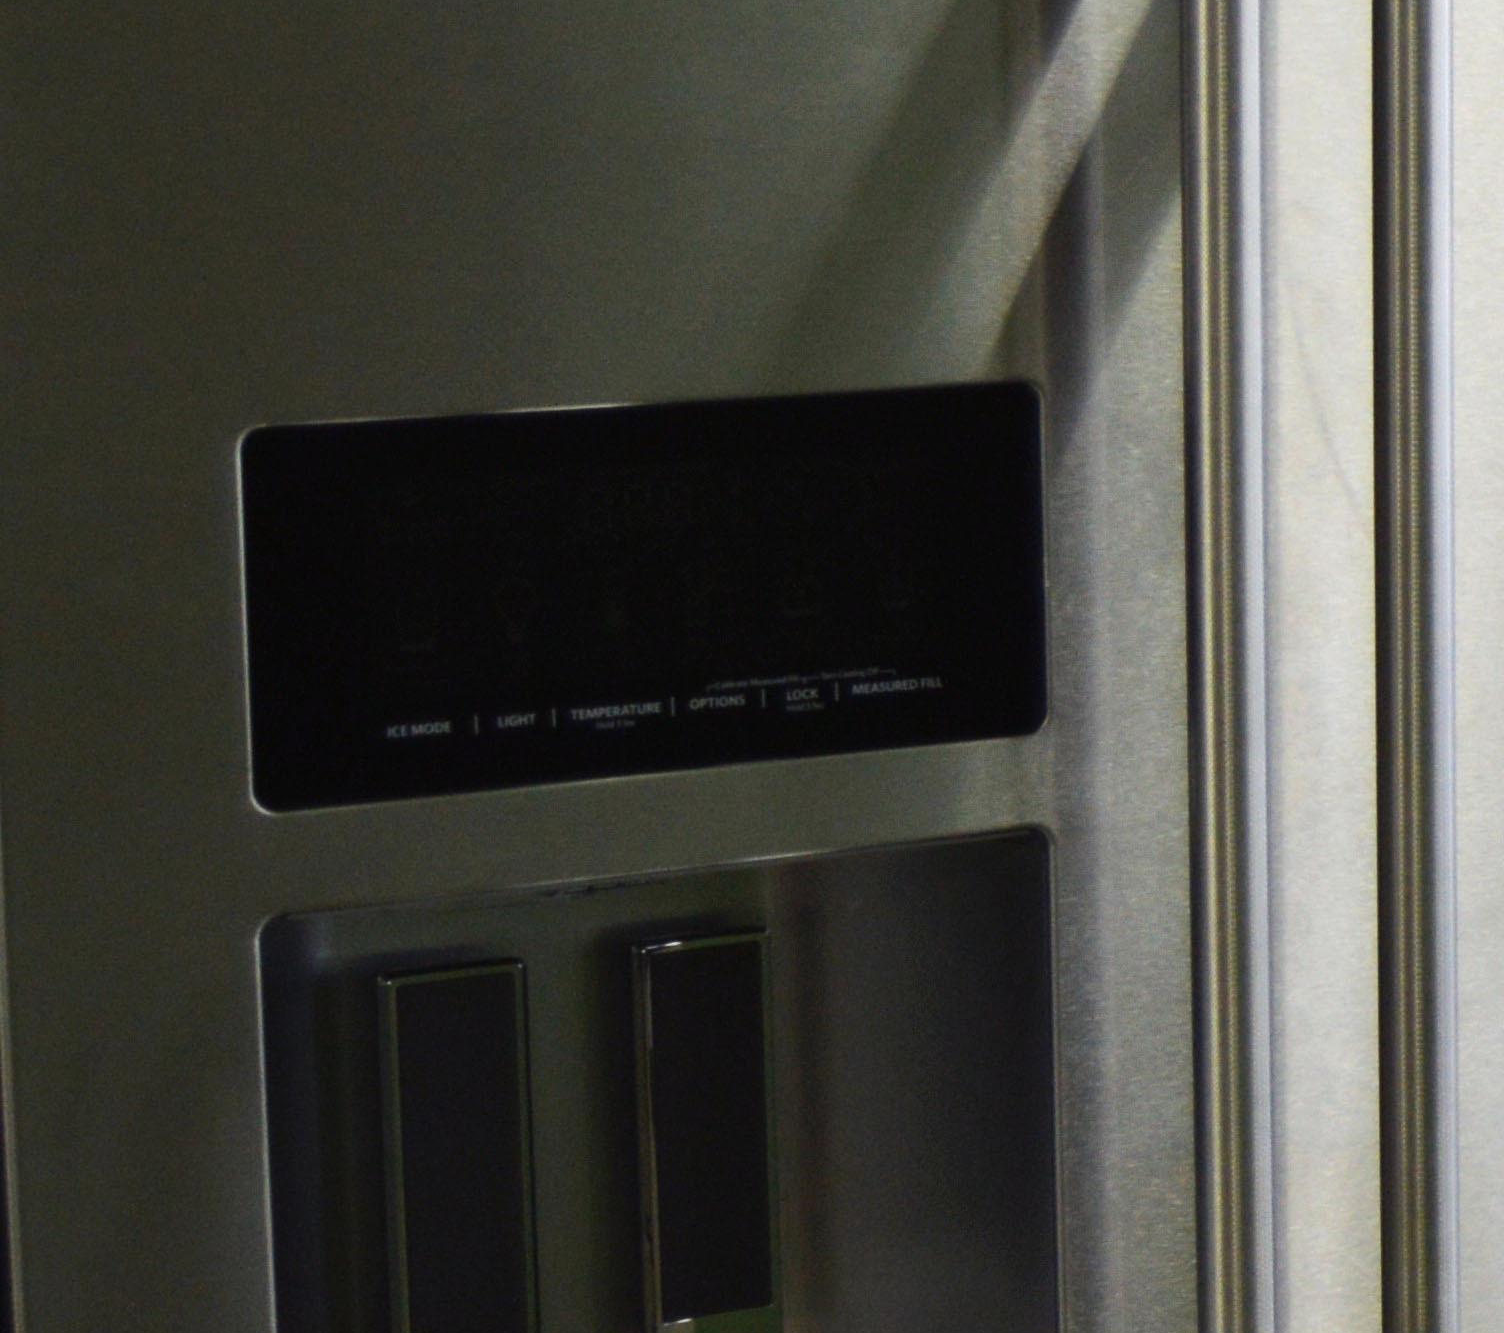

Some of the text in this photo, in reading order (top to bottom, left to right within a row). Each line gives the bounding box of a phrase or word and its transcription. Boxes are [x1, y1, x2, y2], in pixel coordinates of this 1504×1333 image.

[785, 687, 820, 702] LOCK
[851, 676, 944, 696] MEASURED FILL
[571, 701, 662, 721] TEMPERATURE
[689, 694, 746, 711] OPTIONS
[386, 719, 451, 739] ICE MODE
[497, 712, 536, 729] LIGHT
